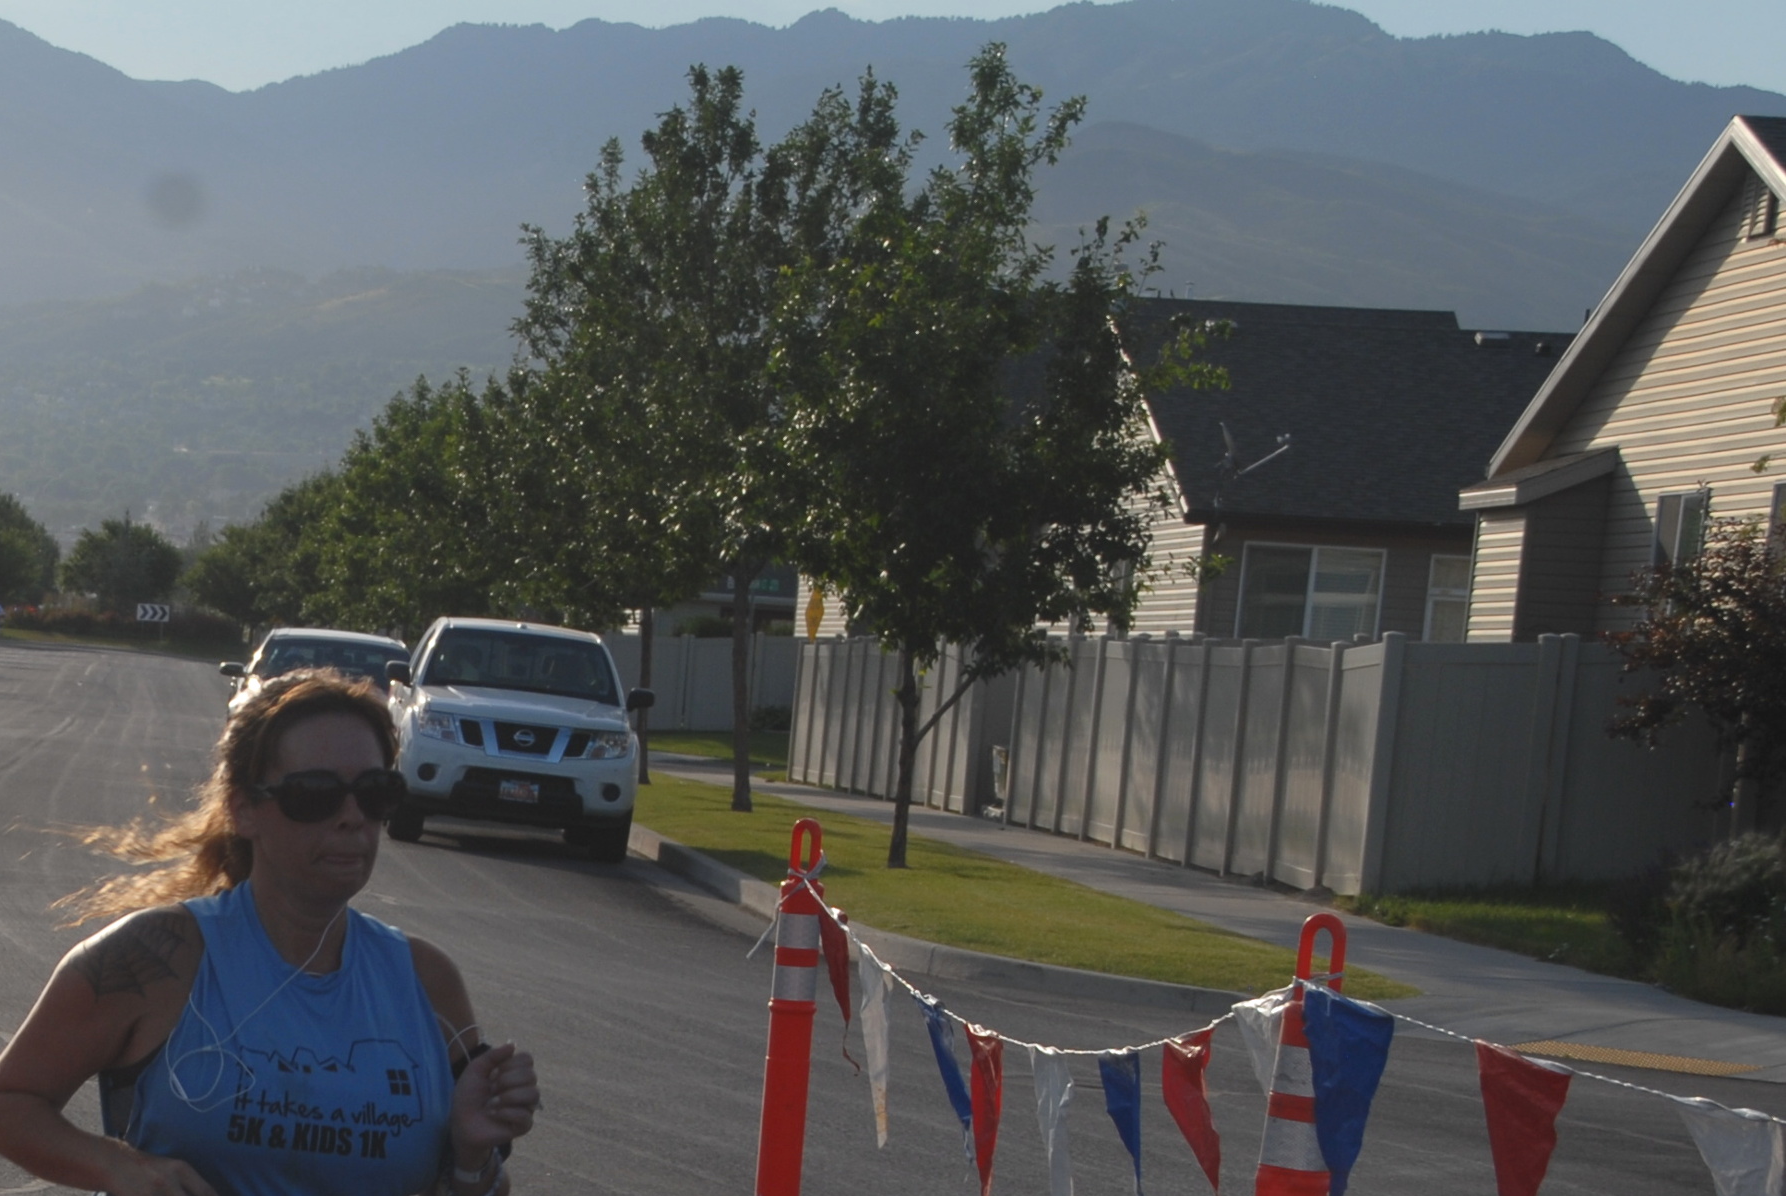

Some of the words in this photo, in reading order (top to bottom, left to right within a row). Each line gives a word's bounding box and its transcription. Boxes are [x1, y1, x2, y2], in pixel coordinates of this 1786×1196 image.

[233, 1083, 252, 1111] It
[256, 1089, 324, 1120] takes
[330, 1107, 346, 1123] a
[351, 1101, 414, 1137] village
[227, 1113, 265, 1146] 5K
[268, 1124, 287, 1149] &
[292, 1122, 353, 1156] KIDS
[358, 1129, 388, 1159] 1K
